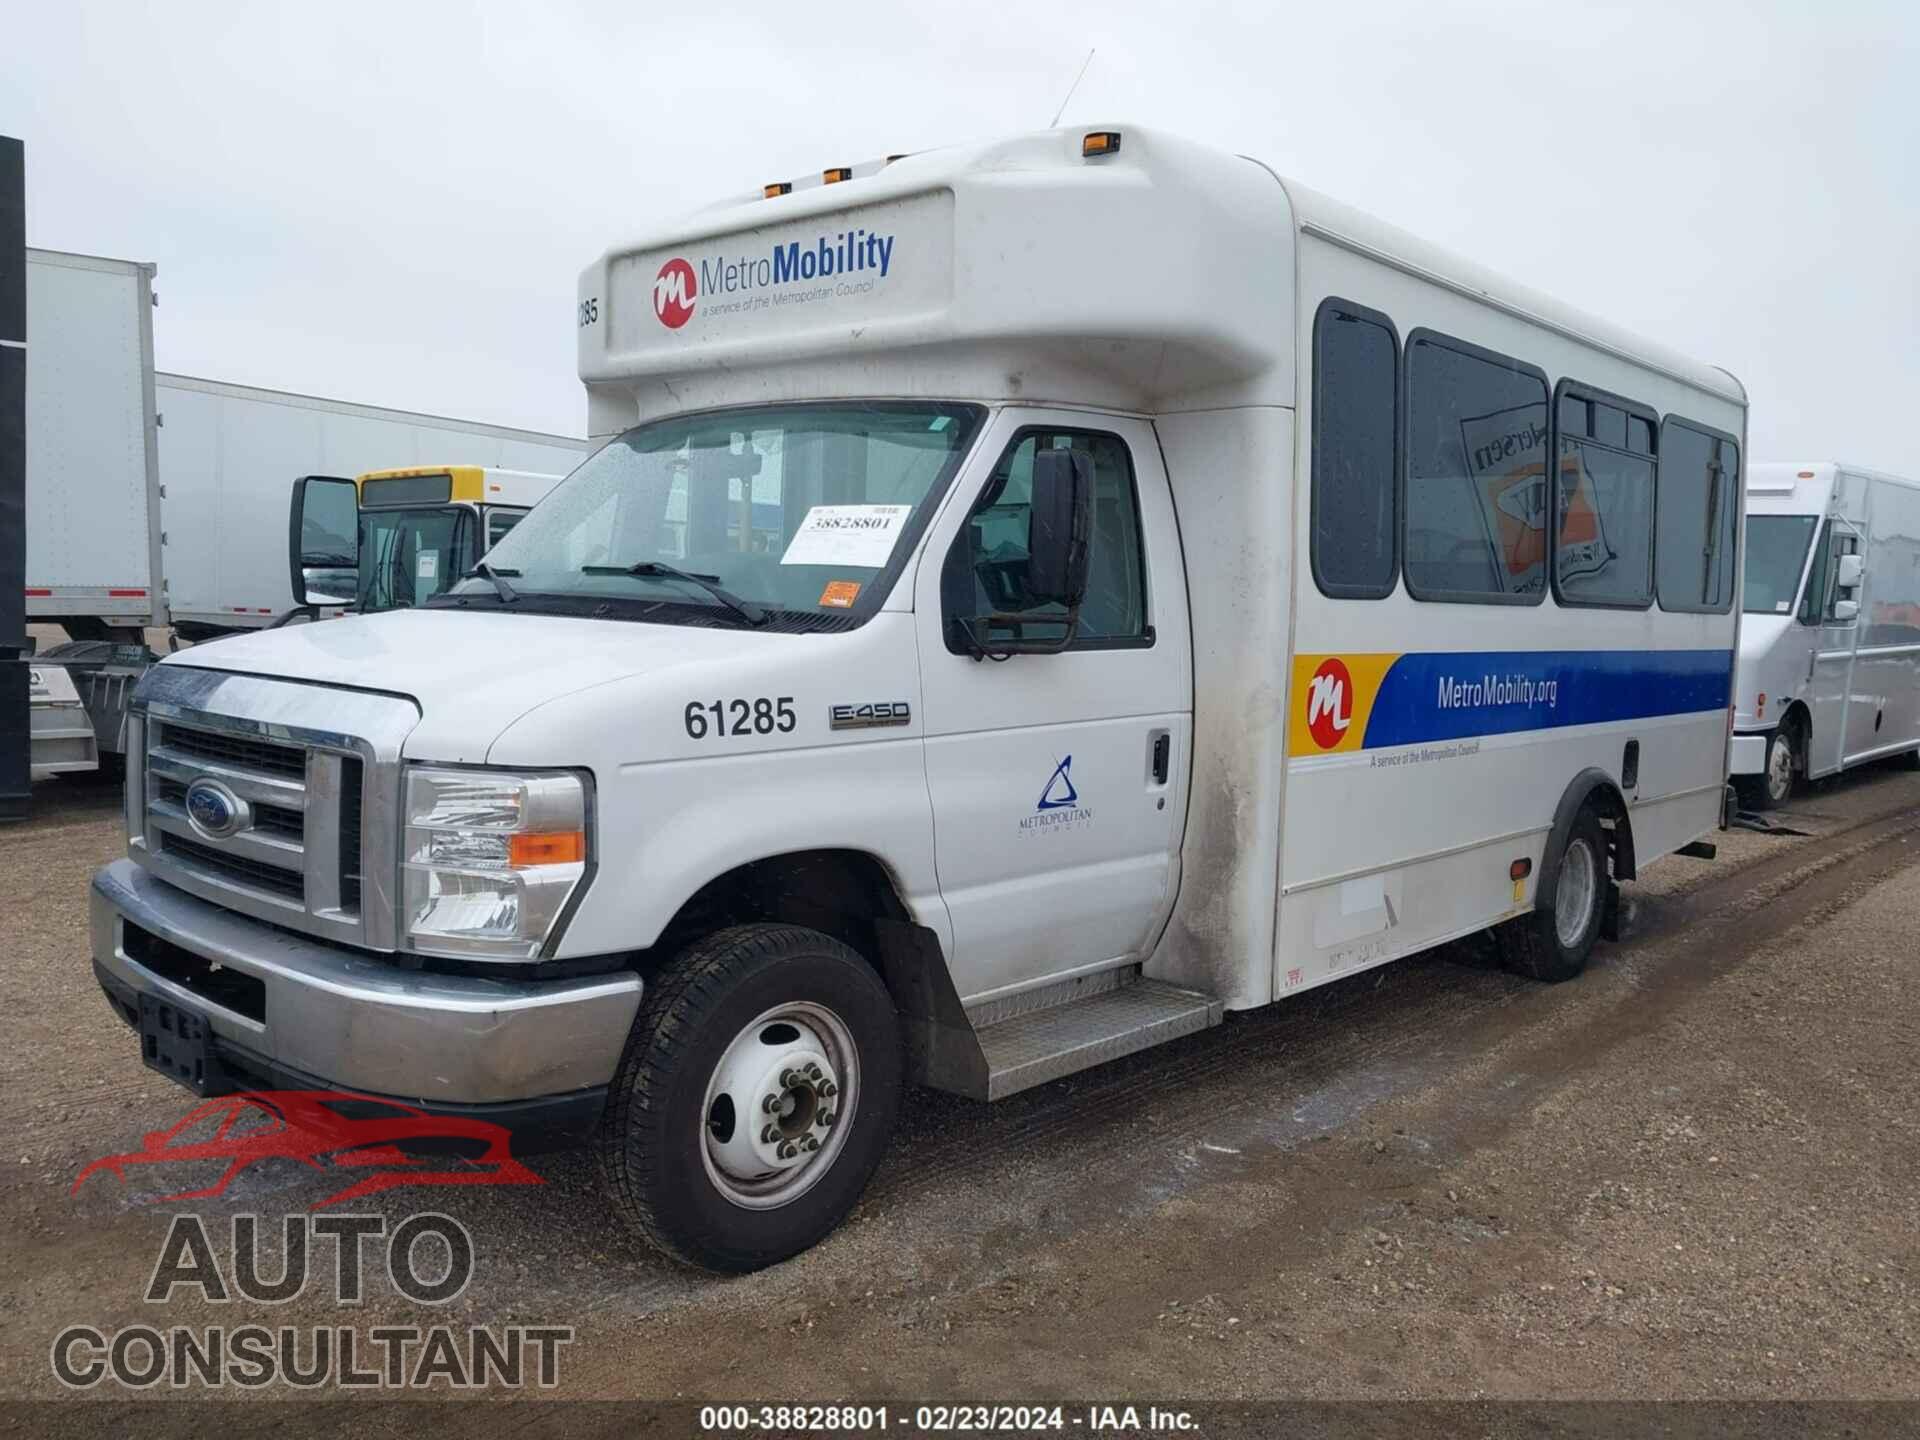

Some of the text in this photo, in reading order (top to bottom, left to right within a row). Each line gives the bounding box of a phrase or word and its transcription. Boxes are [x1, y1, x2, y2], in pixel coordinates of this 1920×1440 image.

[709, 302, 742, 317] service
[754, 297, 769, 312] the
[772, 286, 833, 305] Metropolitan
[836, 278, 875, 297] Council
[810, 517, 891, 530] 38828801
[1438, 674, 1557, 709] MetroMobility.org
[684, 697, 796, 739] 61285
[1020, 808, 1092, 829] METROPOLITAN
